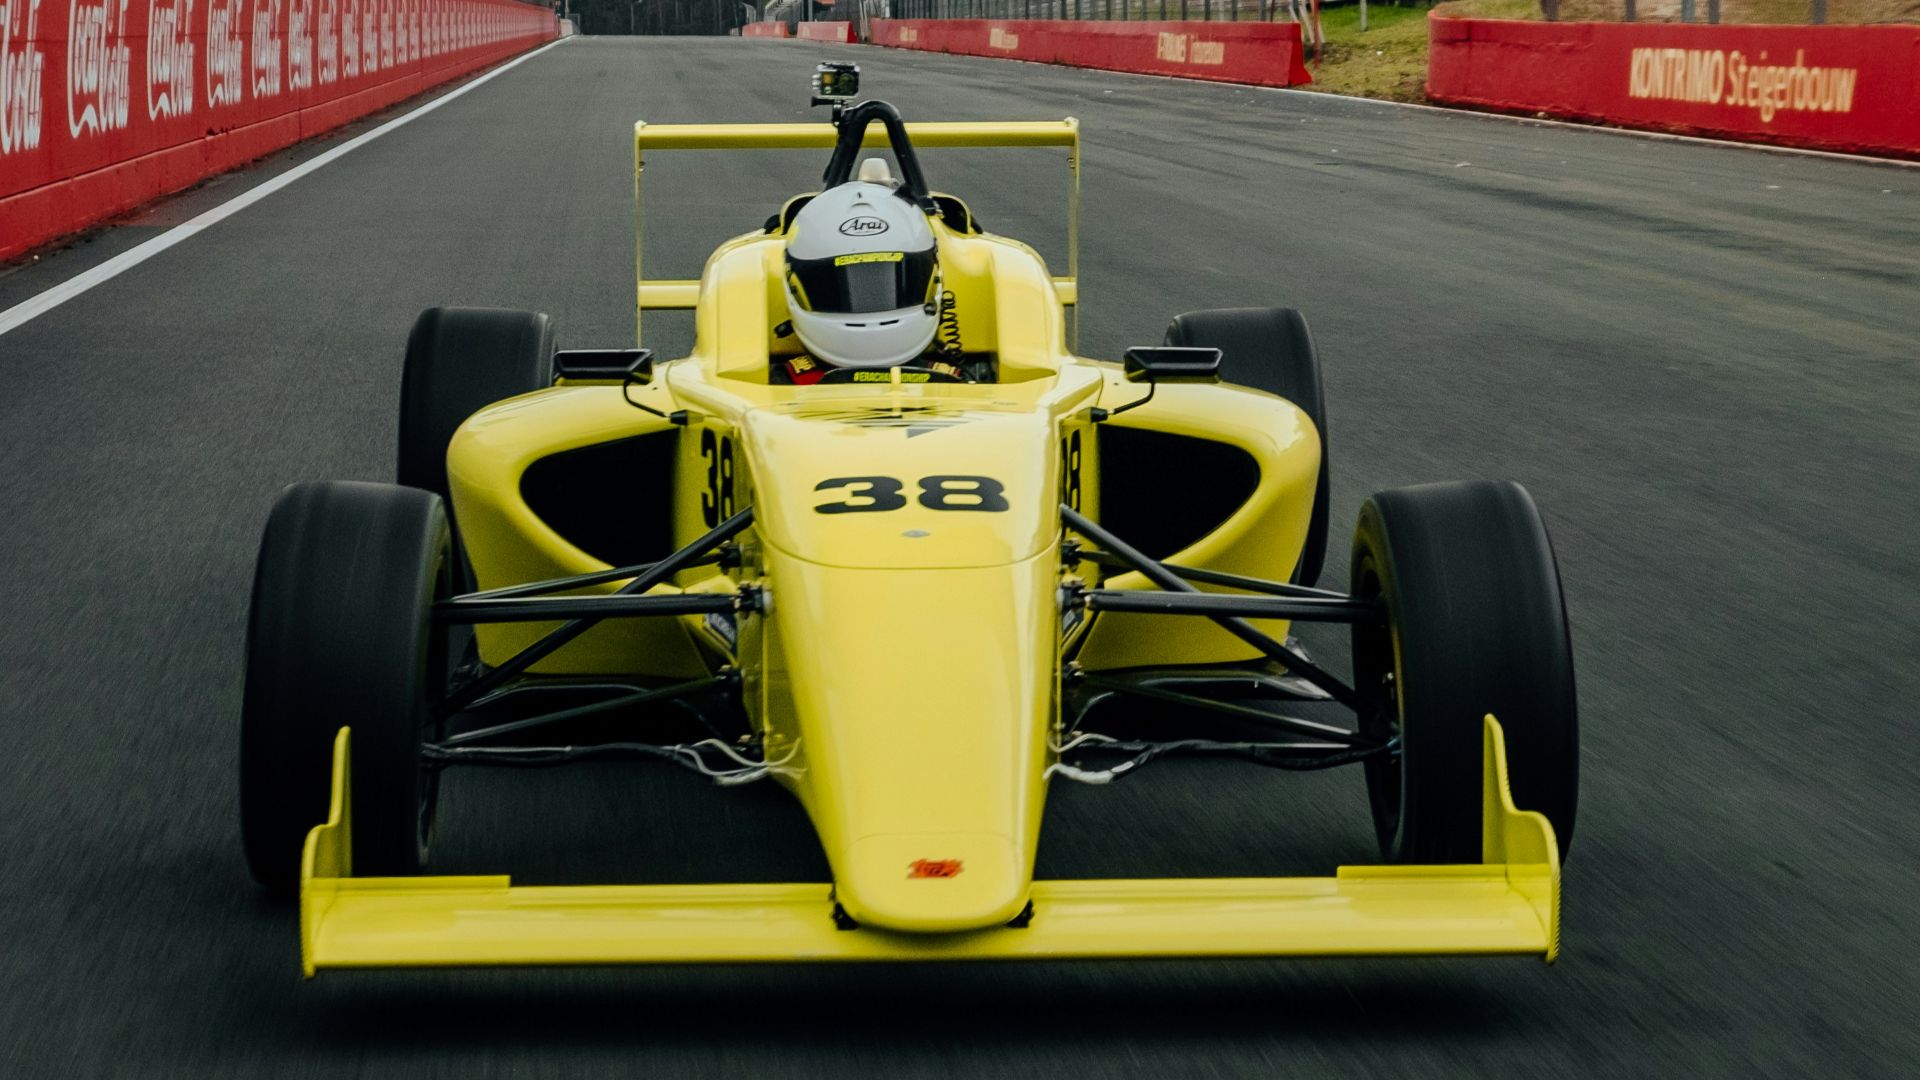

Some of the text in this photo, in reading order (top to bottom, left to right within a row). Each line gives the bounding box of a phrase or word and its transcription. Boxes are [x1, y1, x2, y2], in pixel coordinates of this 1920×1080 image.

[1629, 48, 1857, 123] KONTRIMO Steigerbouw
[843, 218, 883, 232] Arai
[701, 426, 734, 530] 38
[814, 475, 1010, 514] 38
